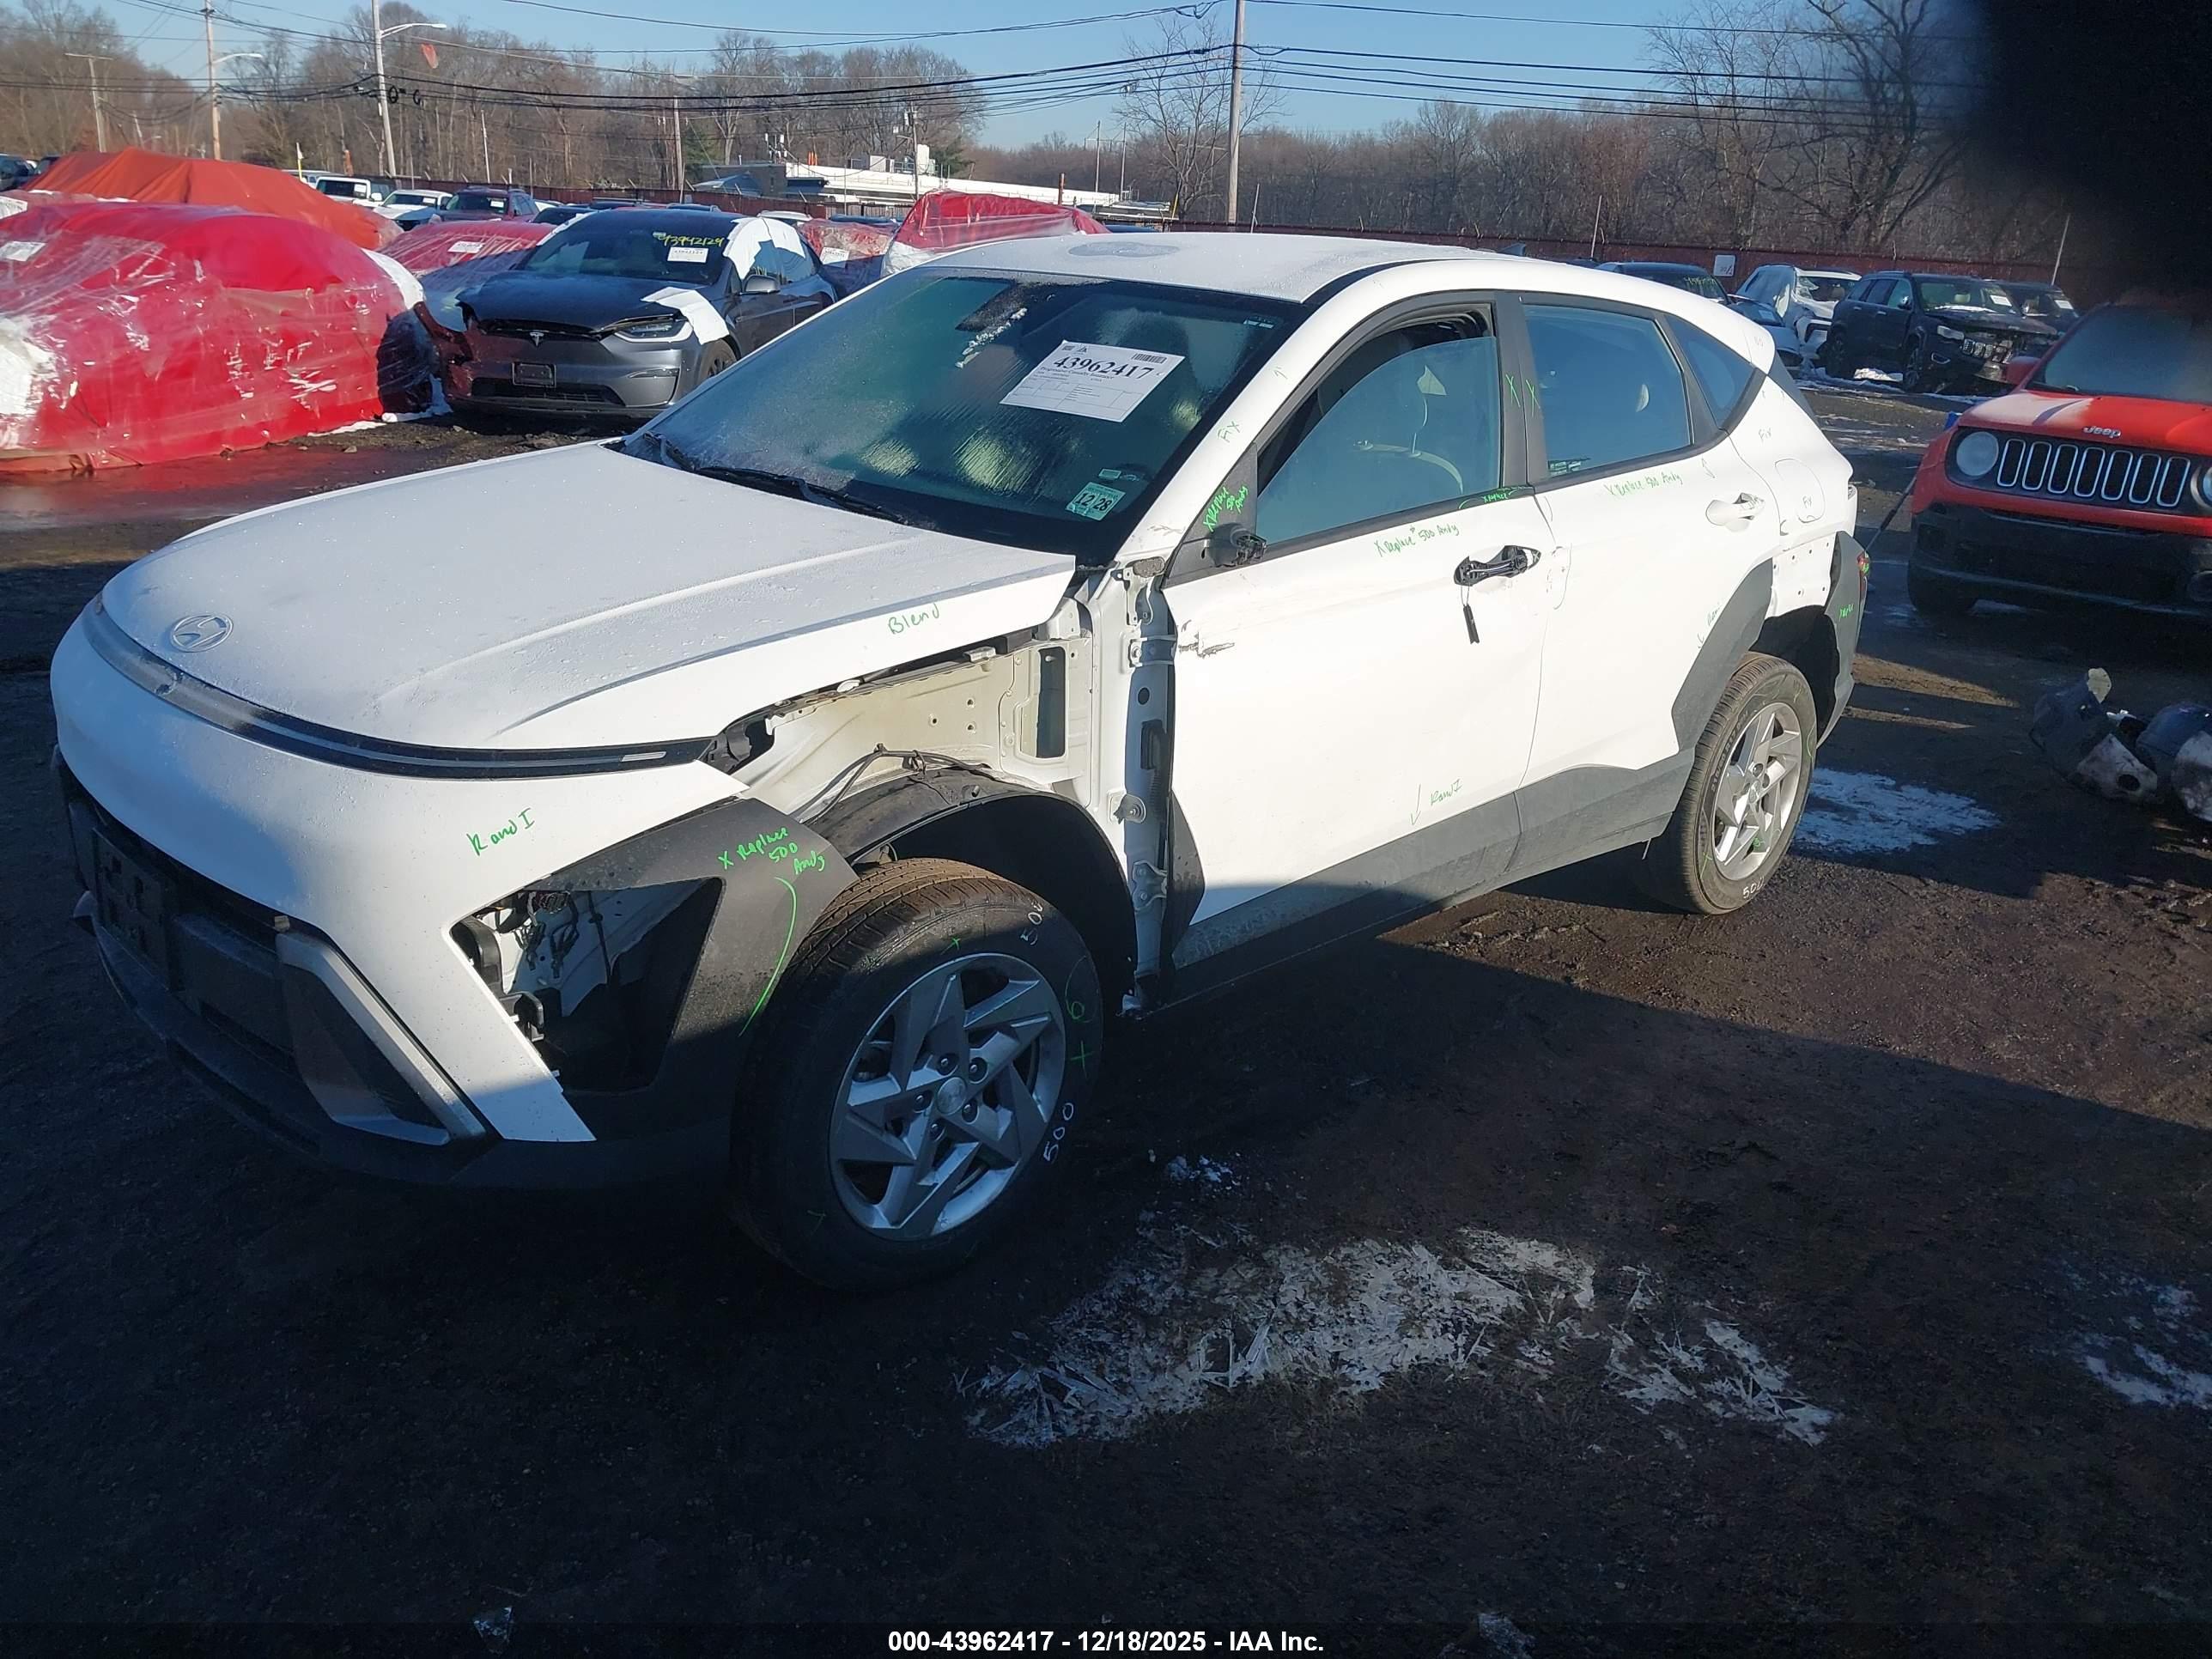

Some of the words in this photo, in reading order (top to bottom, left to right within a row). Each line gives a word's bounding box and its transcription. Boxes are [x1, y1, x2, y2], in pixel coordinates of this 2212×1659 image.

[1054, 356, 1154, 379] 43962417
[2083, 425, 2121, 439] Jeep
[1075, 493, 1095, 506] 12
[1093, 498, 1112, 511] 28
[1419, 529, 1435, 541] 500
[888, 602, 939, 635] Blend
[490, 819, 517, 844] and
[737, 827, 788, 860] Replace
[769, 842, 798, 863] 500
[793, 850, 824, 875] Andy
[1044, 1103, 1074, 1164] 500
